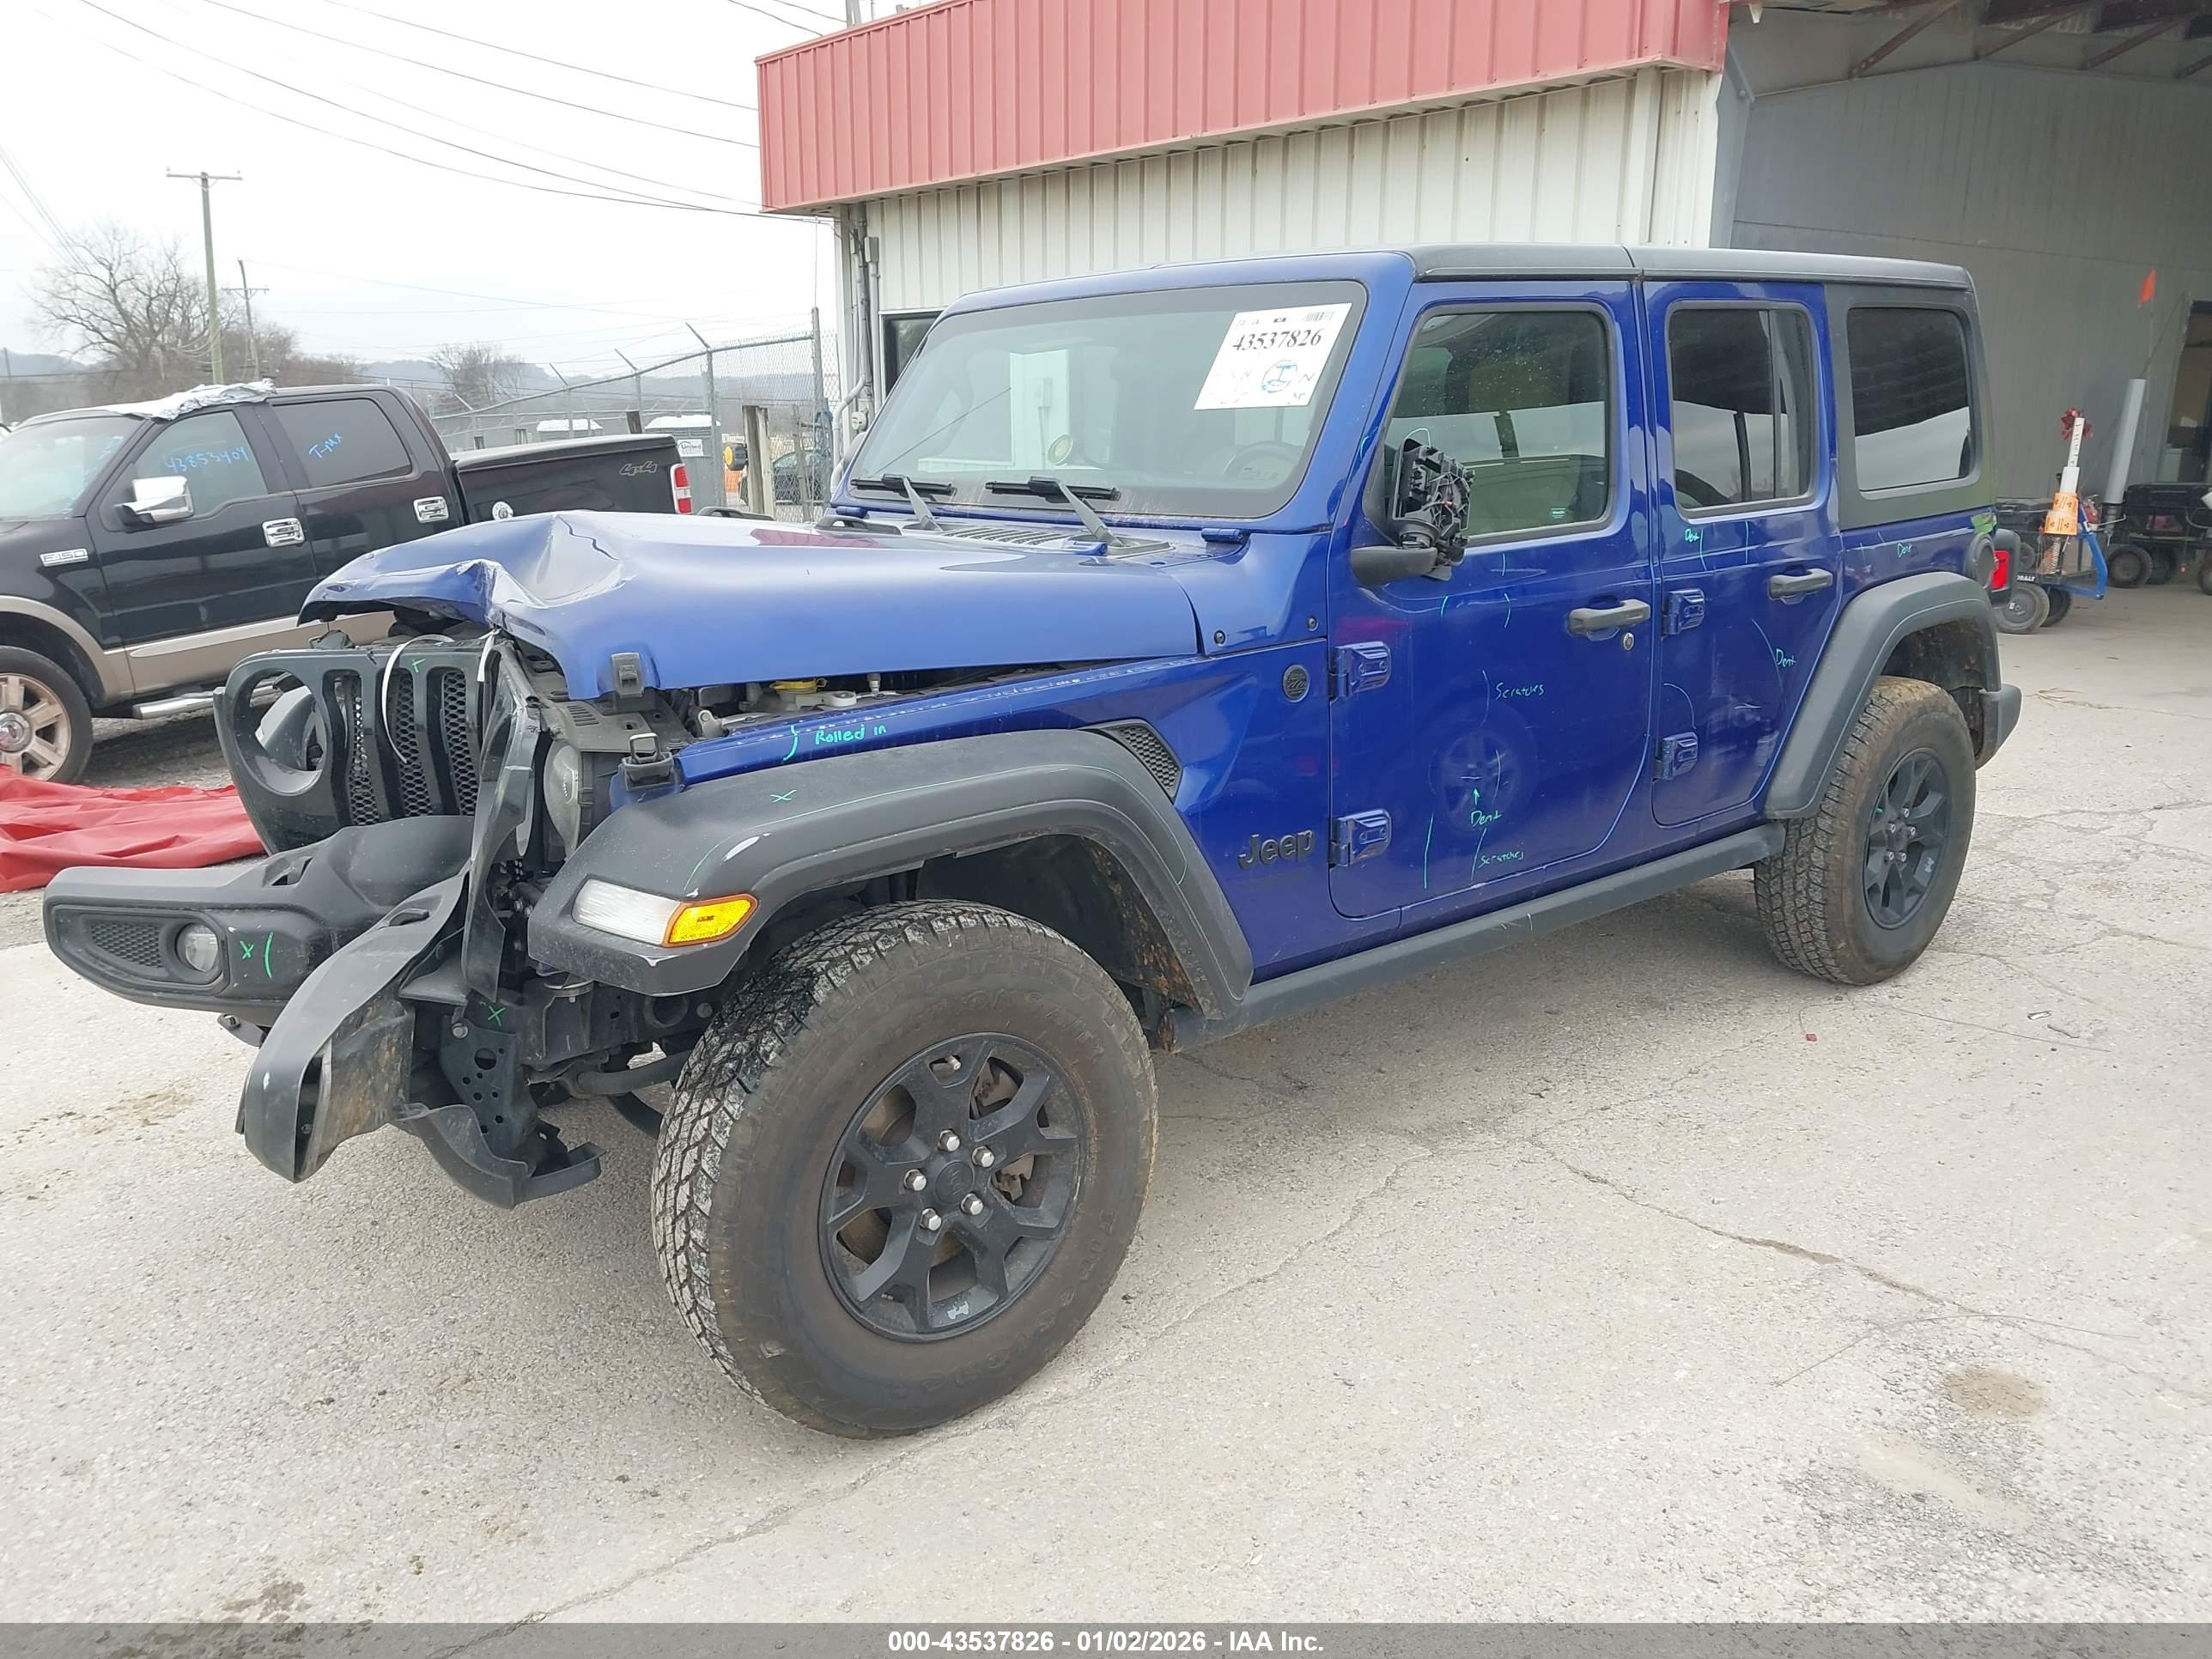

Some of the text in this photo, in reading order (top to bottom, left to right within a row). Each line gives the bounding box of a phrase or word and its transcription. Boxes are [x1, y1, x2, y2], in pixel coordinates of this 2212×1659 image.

[1233, 328, 1325, 351] 43537826
[815, 724, 887, 745] Rolled in
[1471, 810, 1502, 827] Dent
[1237, 830, 1315, 871] Jeep
